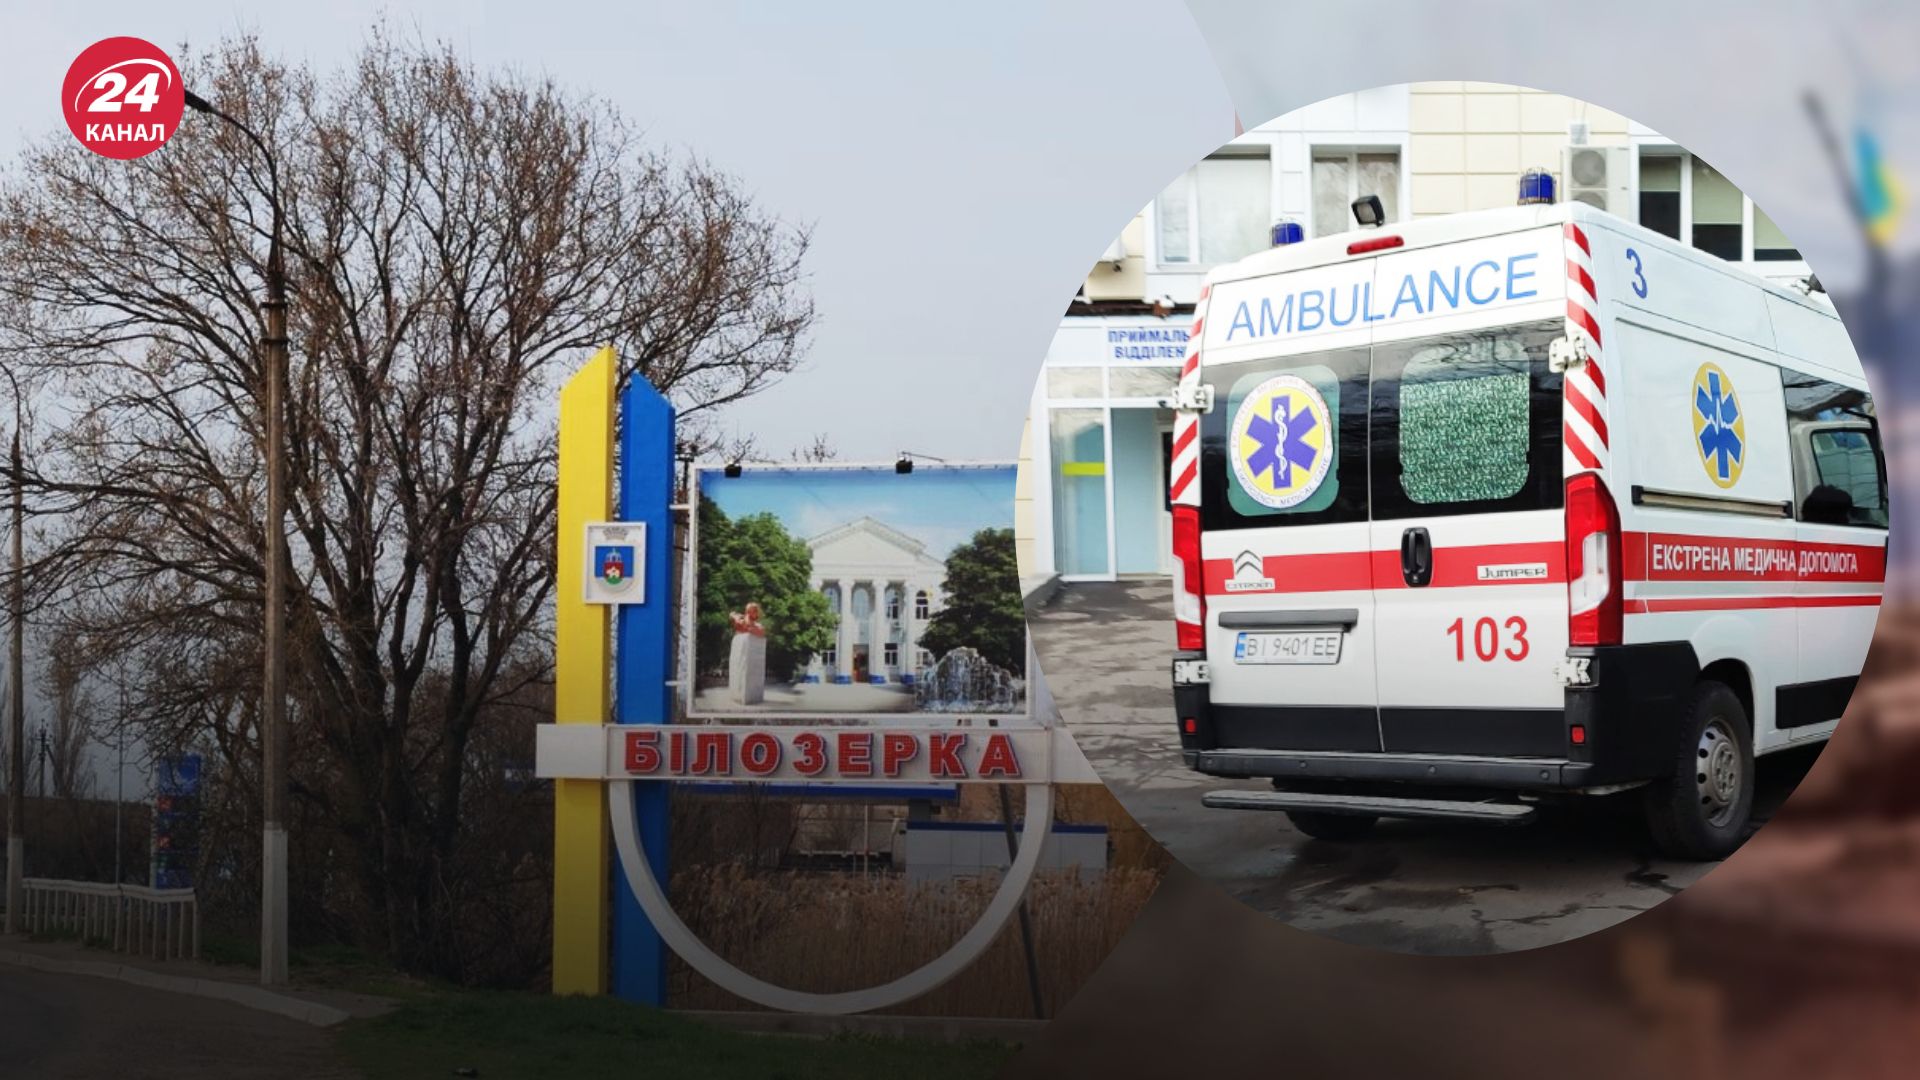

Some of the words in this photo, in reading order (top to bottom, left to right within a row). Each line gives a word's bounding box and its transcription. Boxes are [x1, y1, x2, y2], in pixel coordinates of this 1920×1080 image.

[1626, 248, 1648, 299] 3
[1226, 253, 1538, 342] AMBULANCE
[1108, 326, 1190, 342] ПРИЙМАЛЬ
[1653, 544, 1731, 571] ЕКСТРЕНА
[1734, 547, 1797, 576] МЕДИЧНА
[1799, 550, 1858, 576] ДОПОМОГА
[1447, 615, 1530, 662] 103
[624, 731, 1022, 777] БІЛОЗЕРКА
